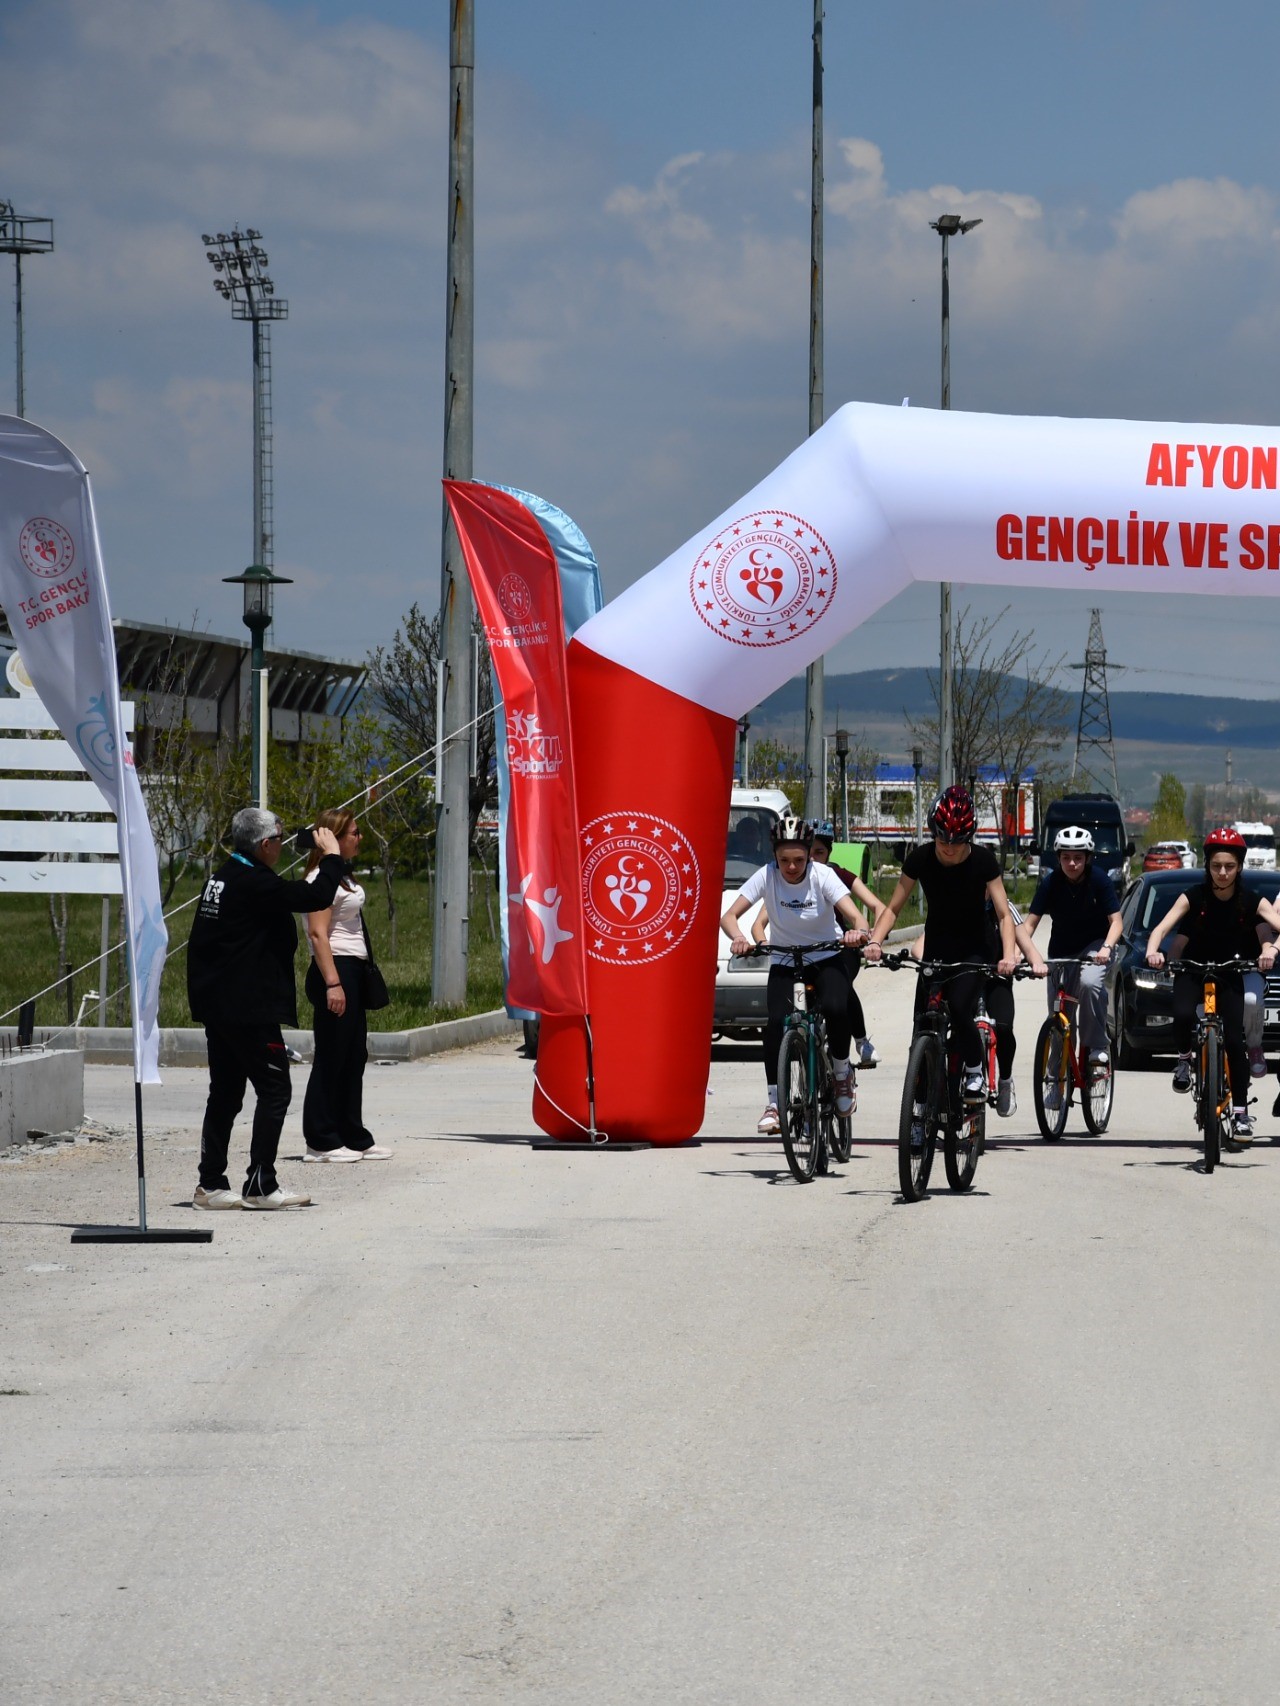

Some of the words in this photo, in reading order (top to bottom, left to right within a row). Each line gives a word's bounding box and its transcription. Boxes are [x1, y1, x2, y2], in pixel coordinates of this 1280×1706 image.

[745, 534, 783, 545] GENÇLİK
[784, 541, 796, 553] VE
[997, 512, 1168, 569] GENÇLİK
[1180, 523, 1228, 568] VE
[715, 540, 744, 595] CUMHURİYETİ
[793, 552, 810, 575] SPOR
[18, 597, 39, 613] T.C.
[721, 597, 756, 622] TÜRKİYE
[780, 577, 810, 619] BAKANLIĞI
[26, 608, 55, 630] SPOR
[503, 621, 540, 636] GENÇLİK
[617, 839, 658, 857] GENÇLİK
[658, 853, 670, 867] VE
[665, 866, 677, 893] SPOR
[584, 901, 612, 934] TÜRKİYE
[637, 895, 676, 936] BAKANLIĞI
